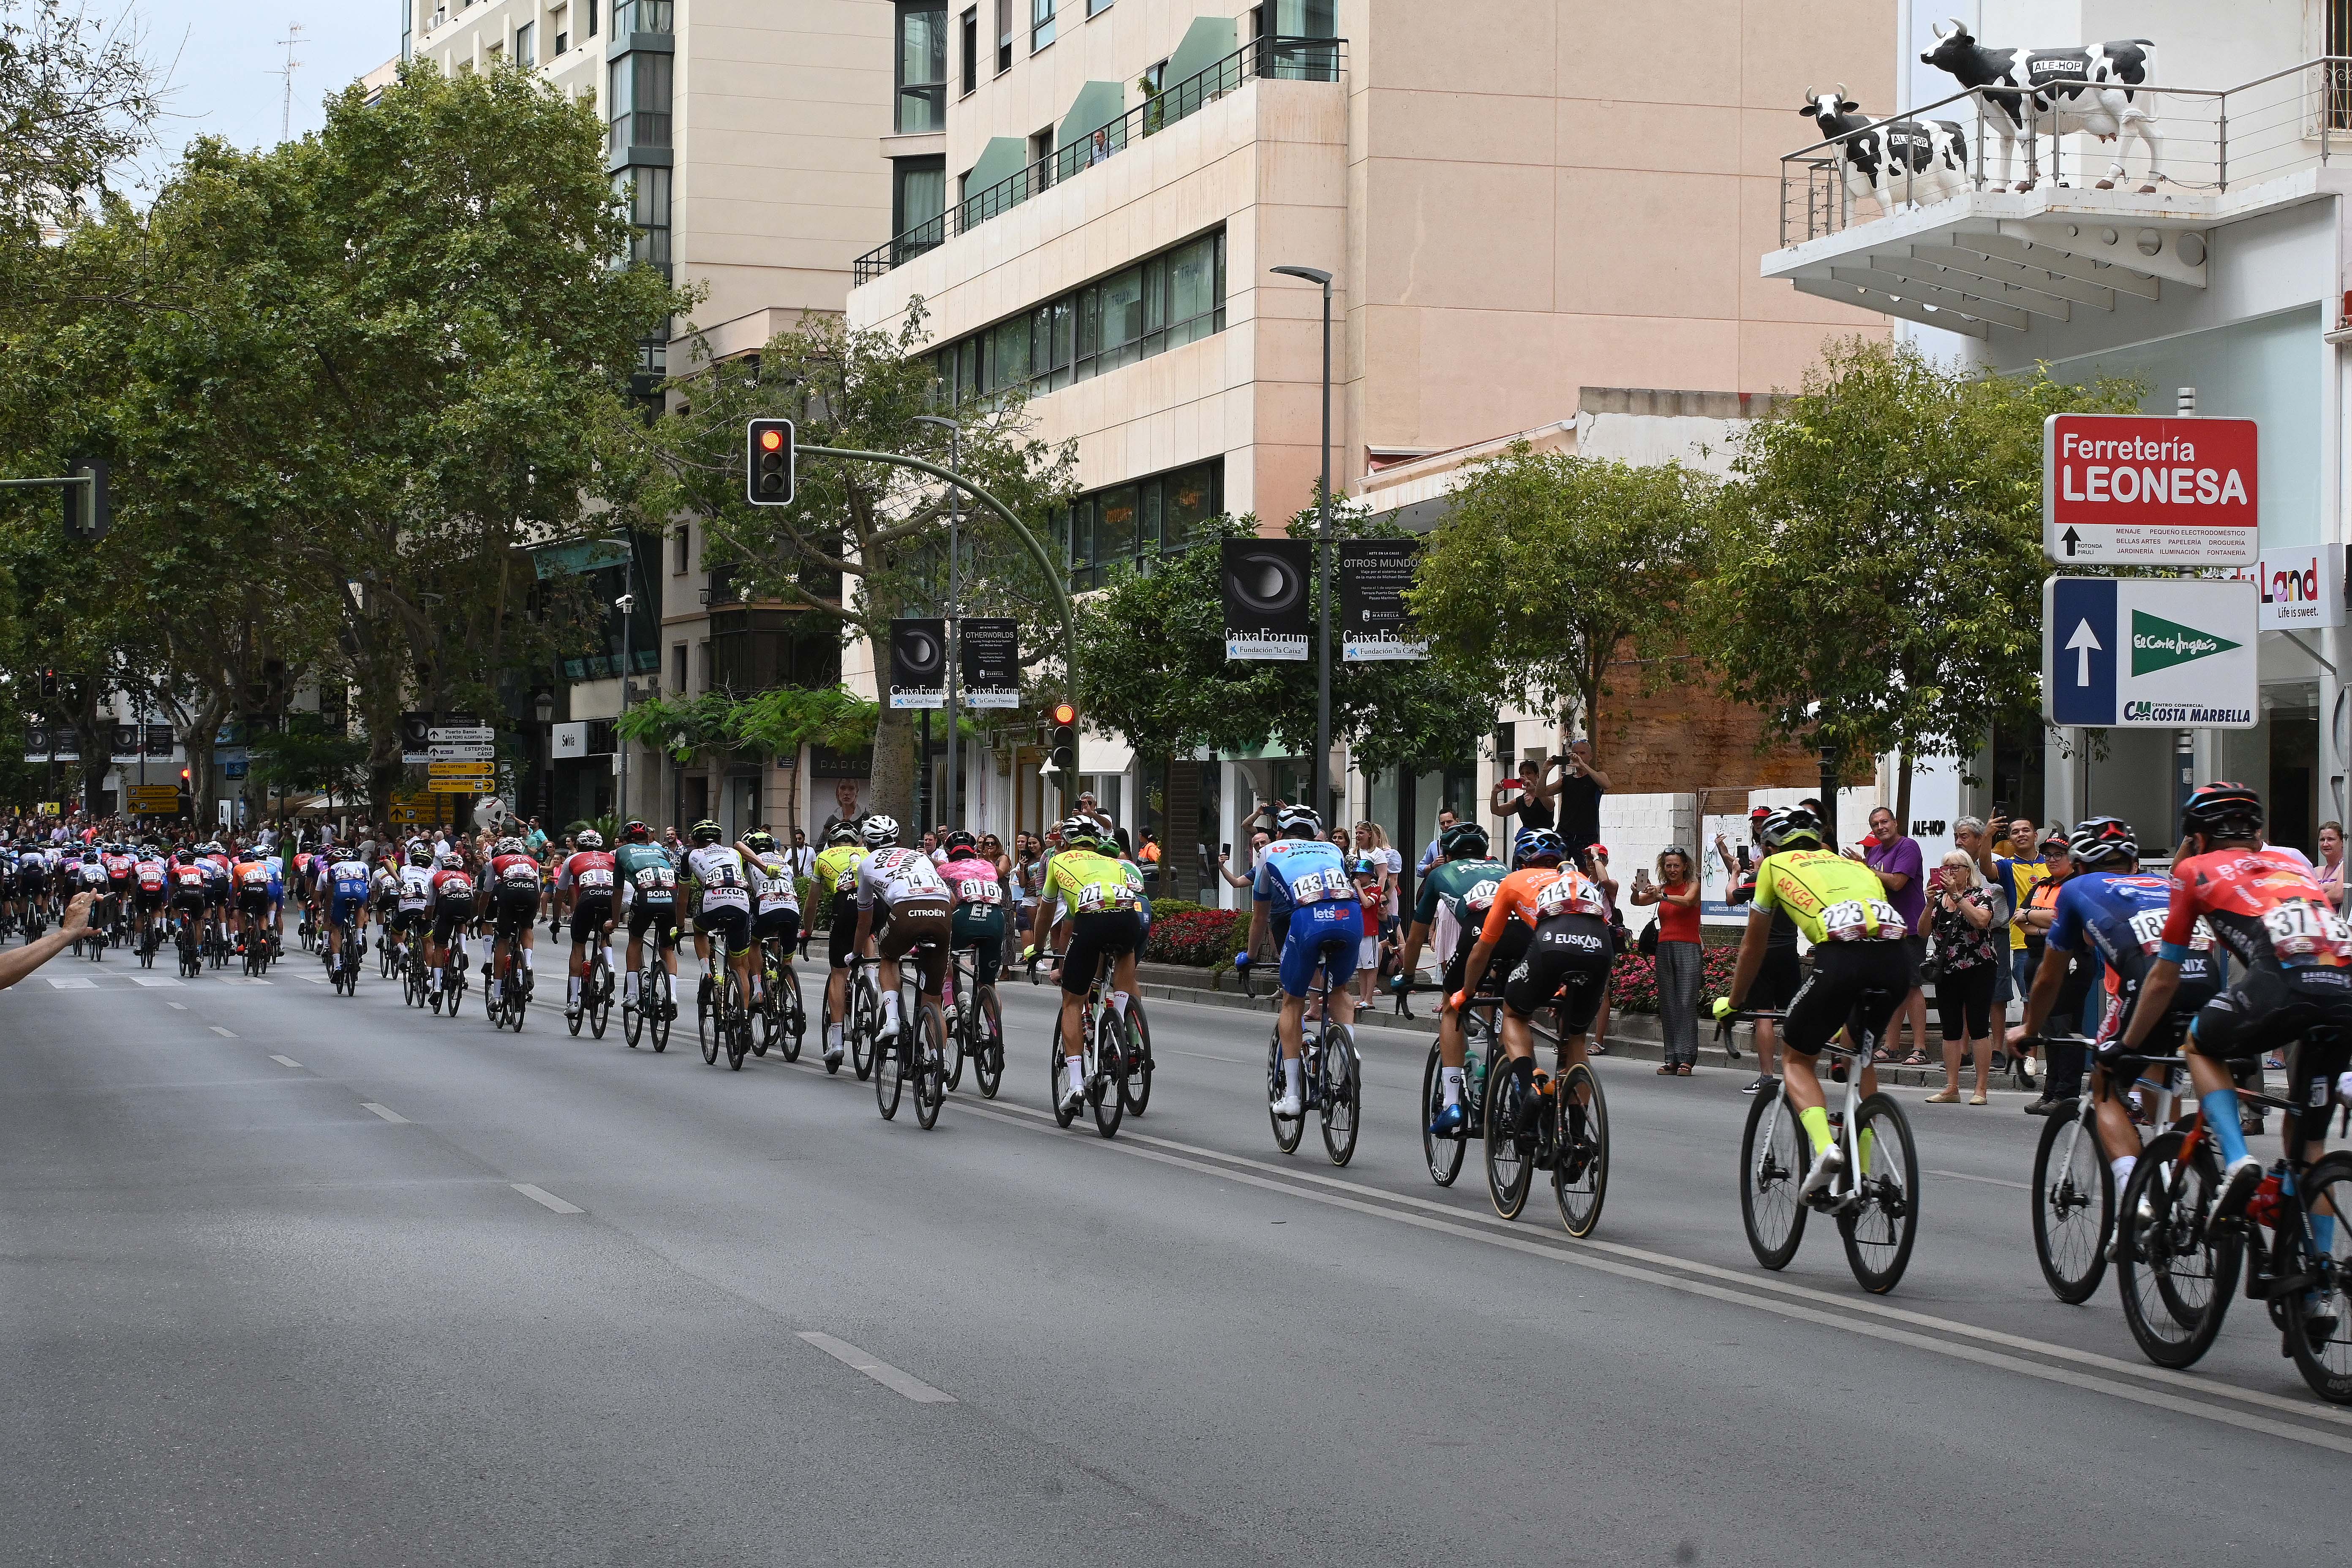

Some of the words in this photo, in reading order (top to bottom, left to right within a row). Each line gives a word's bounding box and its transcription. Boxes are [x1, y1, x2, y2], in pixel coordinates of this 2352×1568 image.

[2035, 61, 2081, 73] ALE-HOP
[2063, 433, 2195, 462] Ferretería
[2063, 465, 2247, 505] LEONESA
[2159, 547, 2200, 555] ILUMINACIÓN
[1344, 559, 1377, 568] OTROS
[2260, 557, 2318, 604] Land
[2278, 607, 2290, 618] Life
[2291, 607, 2297, 618] is
[2298, 607, 2319, 617] sweet.
[1225, 627, 1308, 644] CaixaForum
[2134, 634, 2146, 649] El
[2146, 635, 2175, 650] Corte
[2175, 632, 2217, 655] Inglés
[964, 684, 1019, 696] CaixaForum
[2152, 708, 2186, 721] COSTA
[2190, 709, 2250, 723] MARBELLA
[562, 733, 574, 747] Solvia
[1912, 820, 1945, 836] ALE-HOP
[583, 873, 594, 883] 53
[606, 872, 613, 882] 5
[662, 871, 673, 881] 46
[707, 869, 721, 882] 96
[838, 868, 855, 886] 225
[905, 874, 922, 888] 14
[928, 875, 945, 888] 14
[1055, 870, 1076, 890] ARKEA
[403, 885, 413, 893] 95
[712, 887, 744, 896] Circus
[762, 881, 776, 893] 94
[964, 882, 977, 895] 61
[988, 885, 1000, 898] 61
[1294, 875, 1322, 897] 143
[1470, 883, 1497, 901] 202
[1777, 877, 1814, 910] ARKEA
[1078, 885, 1100, 906] 227
[1112, 885, 1134, 899] 22
[1538, 882, 1566, 906] 214
[908, 908, 946, 917] CITROËN
[970, 903, 992, 917] EF
[1824, 903, 1864, 929] 223
[2274, 908, 2306, 937] 37
